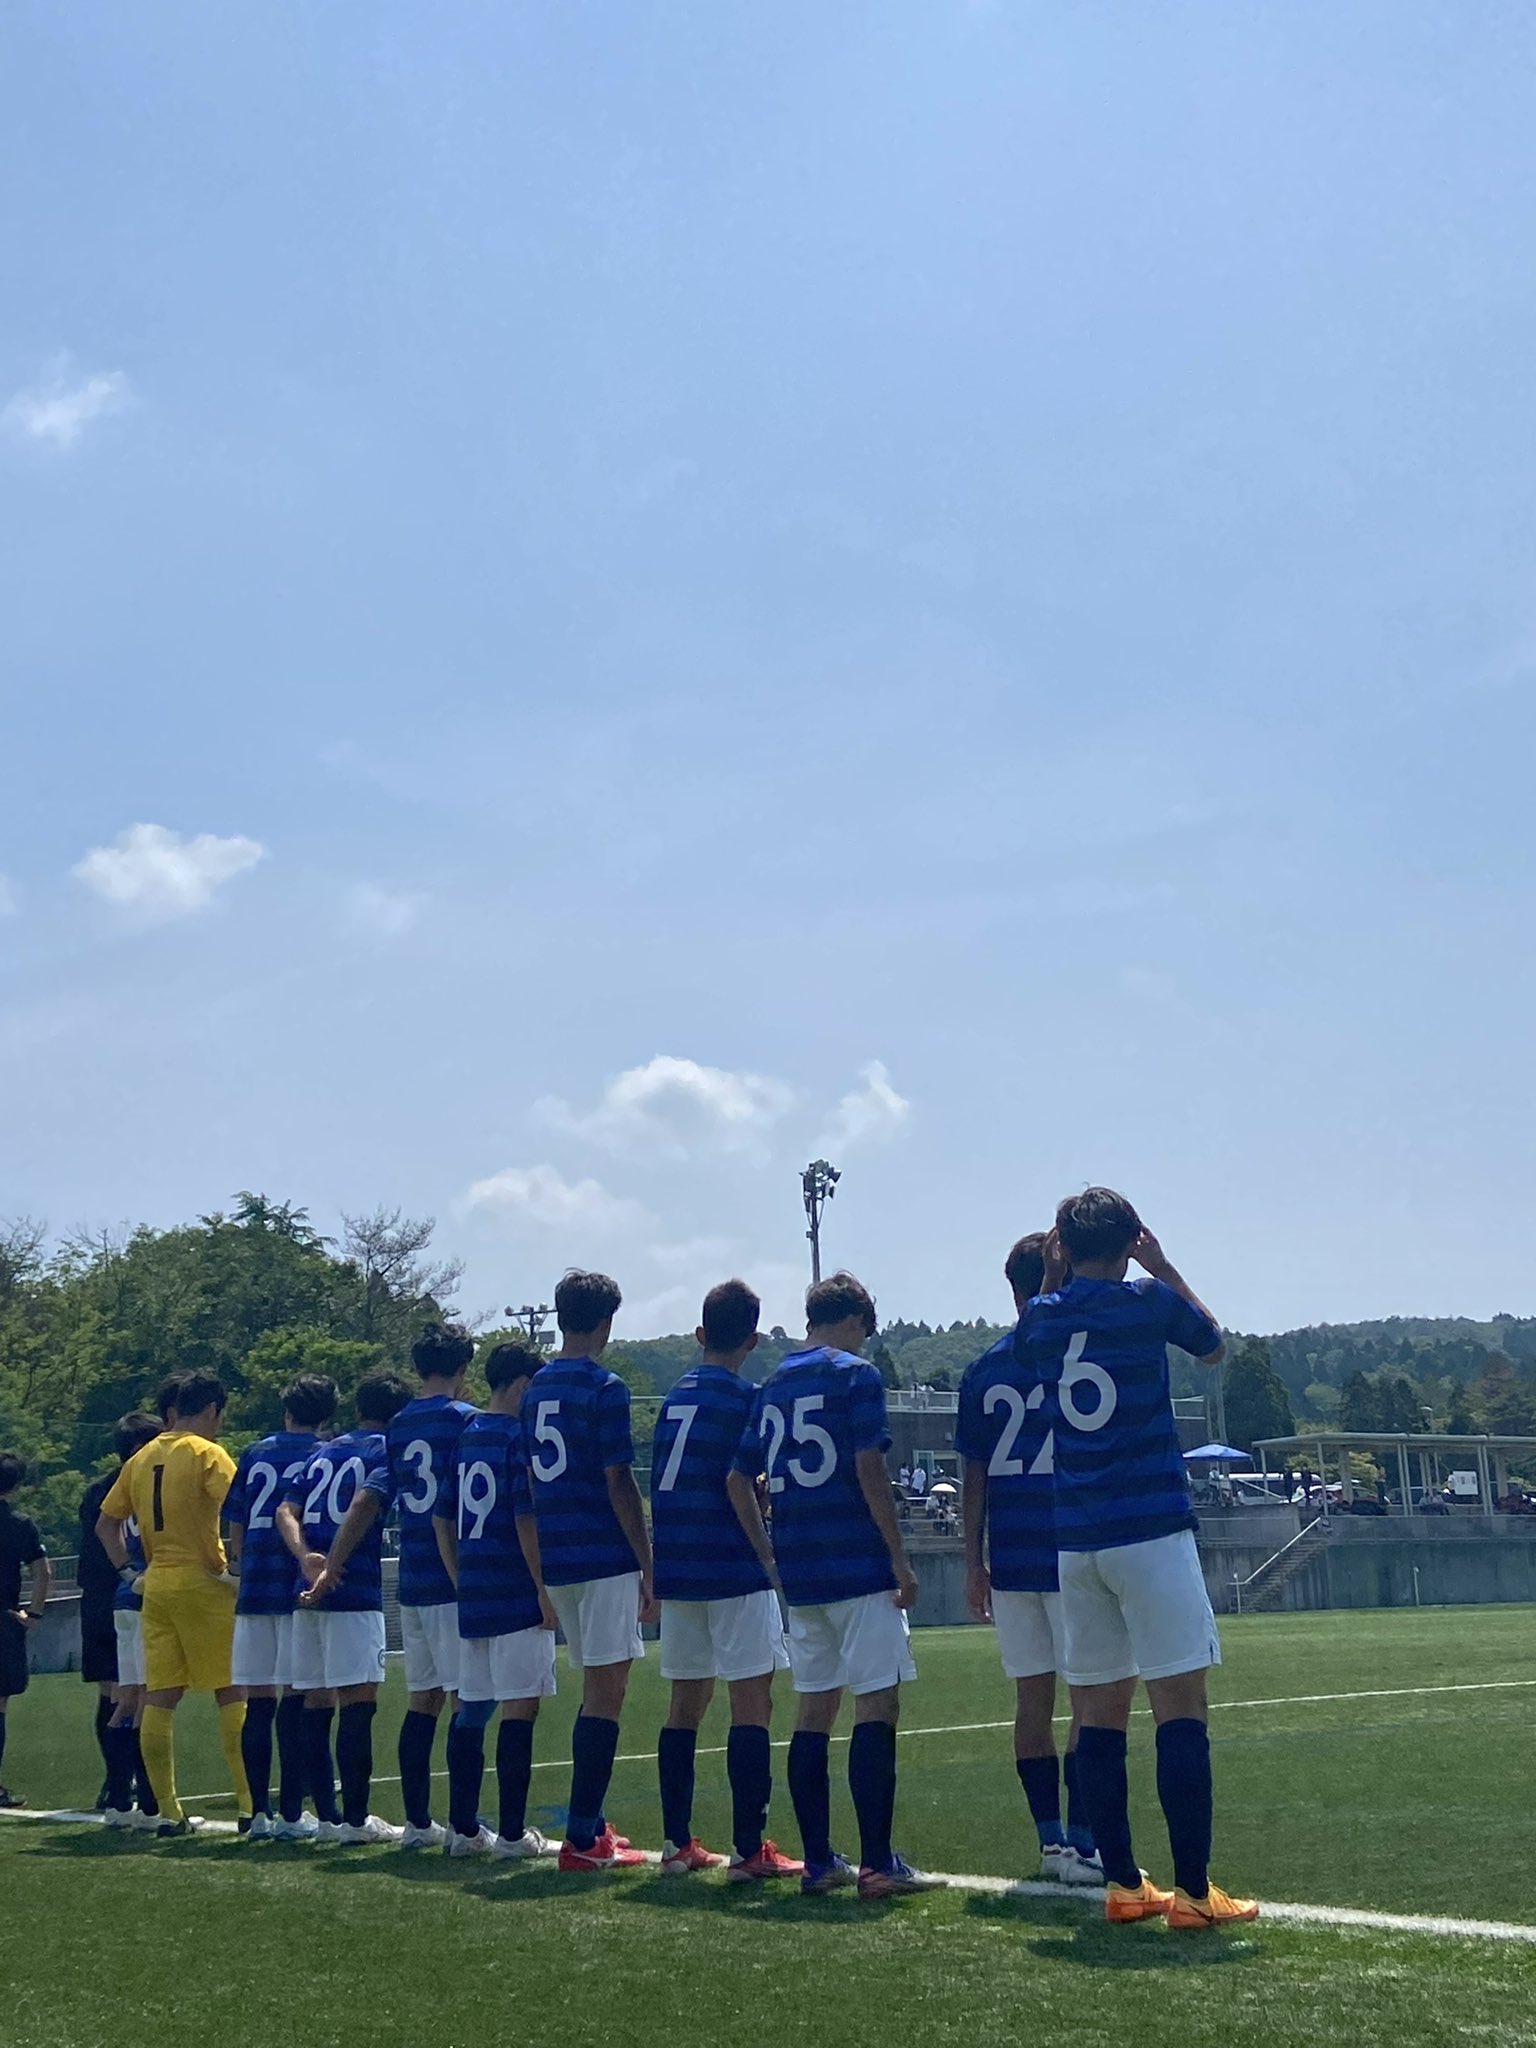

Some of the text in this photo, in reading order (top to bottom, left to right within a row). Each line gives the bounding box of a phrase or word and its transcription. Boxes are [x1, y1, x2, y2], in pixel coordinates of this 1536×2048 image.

[1058, 1331, 1117, 1432] 6
[402, 1439, 438, 1514] 3
[531, 1399, 568, 1483] 5
[658, 1405, 699, 1491] 7
[759, 1394, 838, 1493] 25
[153, 1463, 165, 1533] 1
[302, 1456, 366, 1525] 20
[457, 1460, 497, 1540] 19
